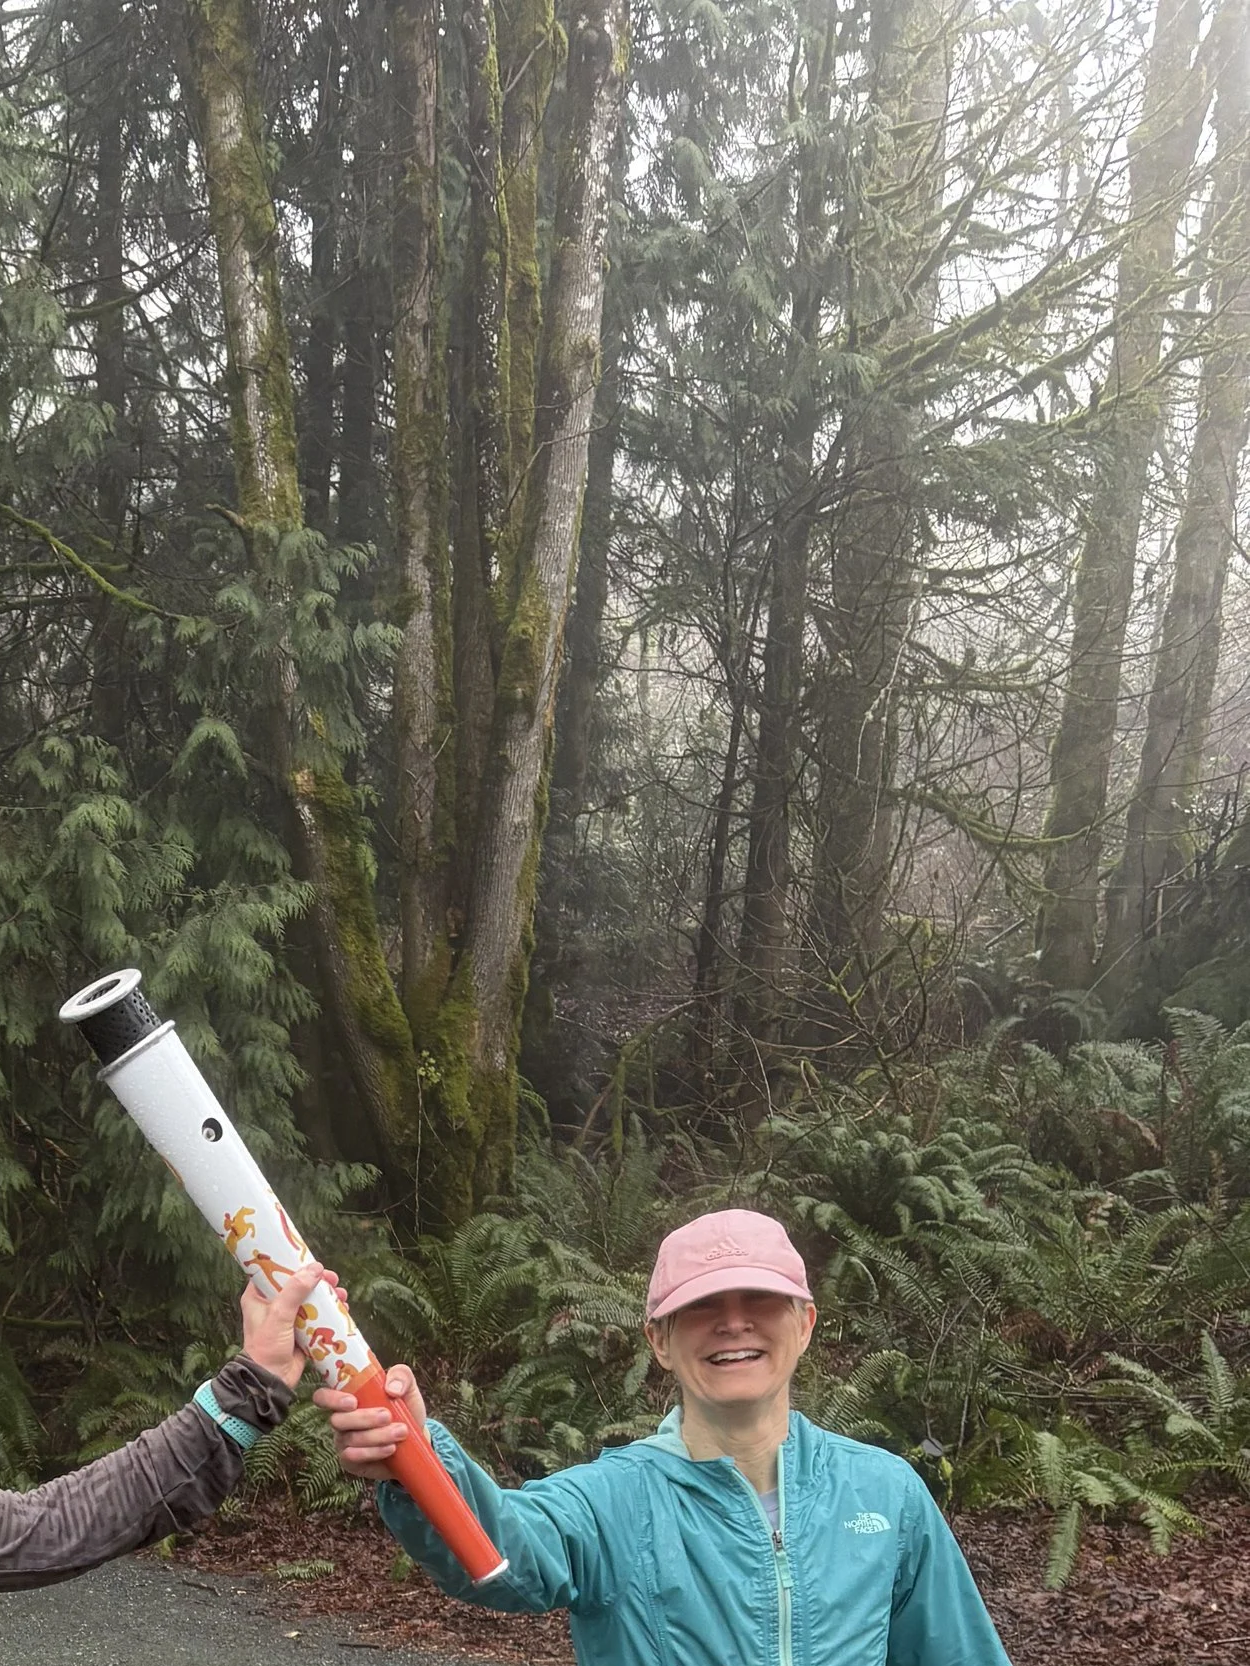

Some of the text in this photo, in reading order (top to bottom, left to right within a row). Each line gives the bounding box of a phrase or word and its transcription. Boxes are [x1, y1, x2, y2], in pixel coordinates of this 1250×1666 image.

[705, 1247, 749, 1260] adidas
[856, 1512, 870, 1520] THE
[844, 1520, 872, 1528] NORTH
